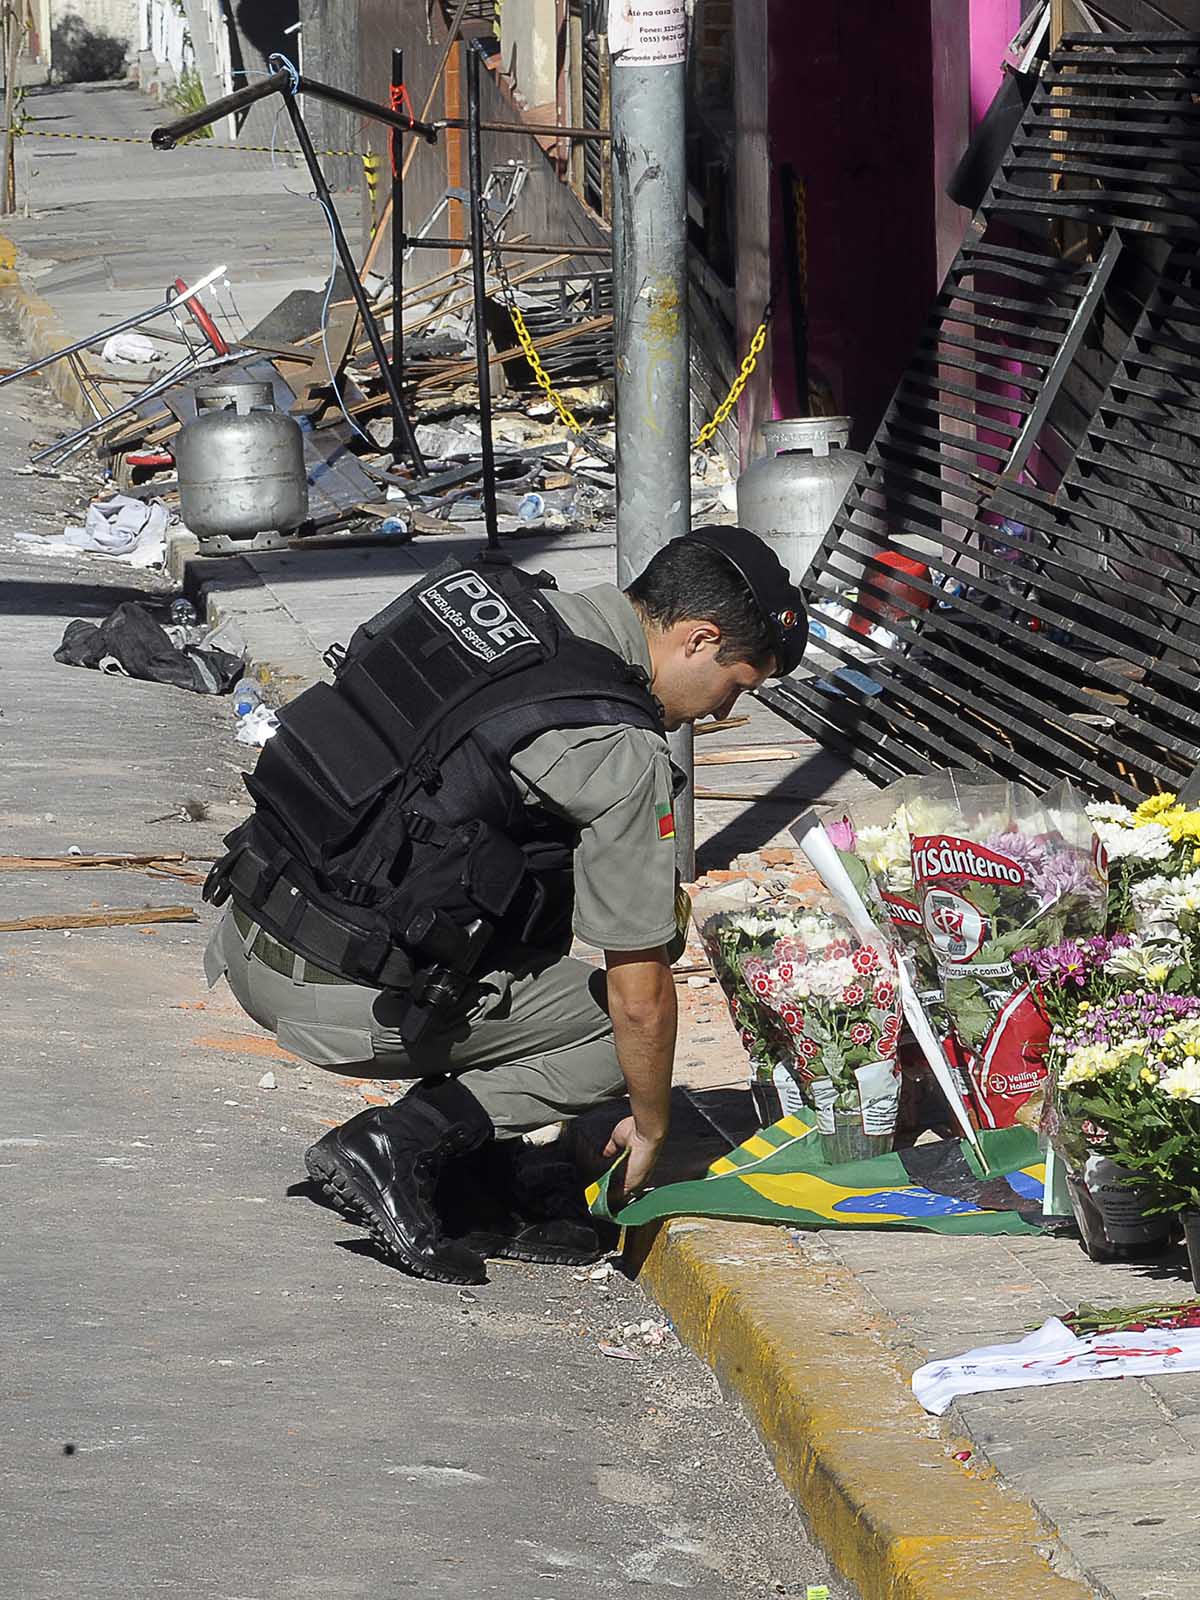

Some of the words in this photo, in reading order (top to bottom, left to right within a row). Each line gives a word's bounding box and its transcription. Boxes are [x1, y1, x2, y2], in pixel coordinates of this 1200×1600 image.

[426, 588, 467, 628] OPERAÇÕES
[460, 626, 497, 660] ESPECIAIS
[444, 576, 529, 646] POE
[911, 839, 1022, 884] risântemo
[1008, 1079, 1042, 1091] Holamb
